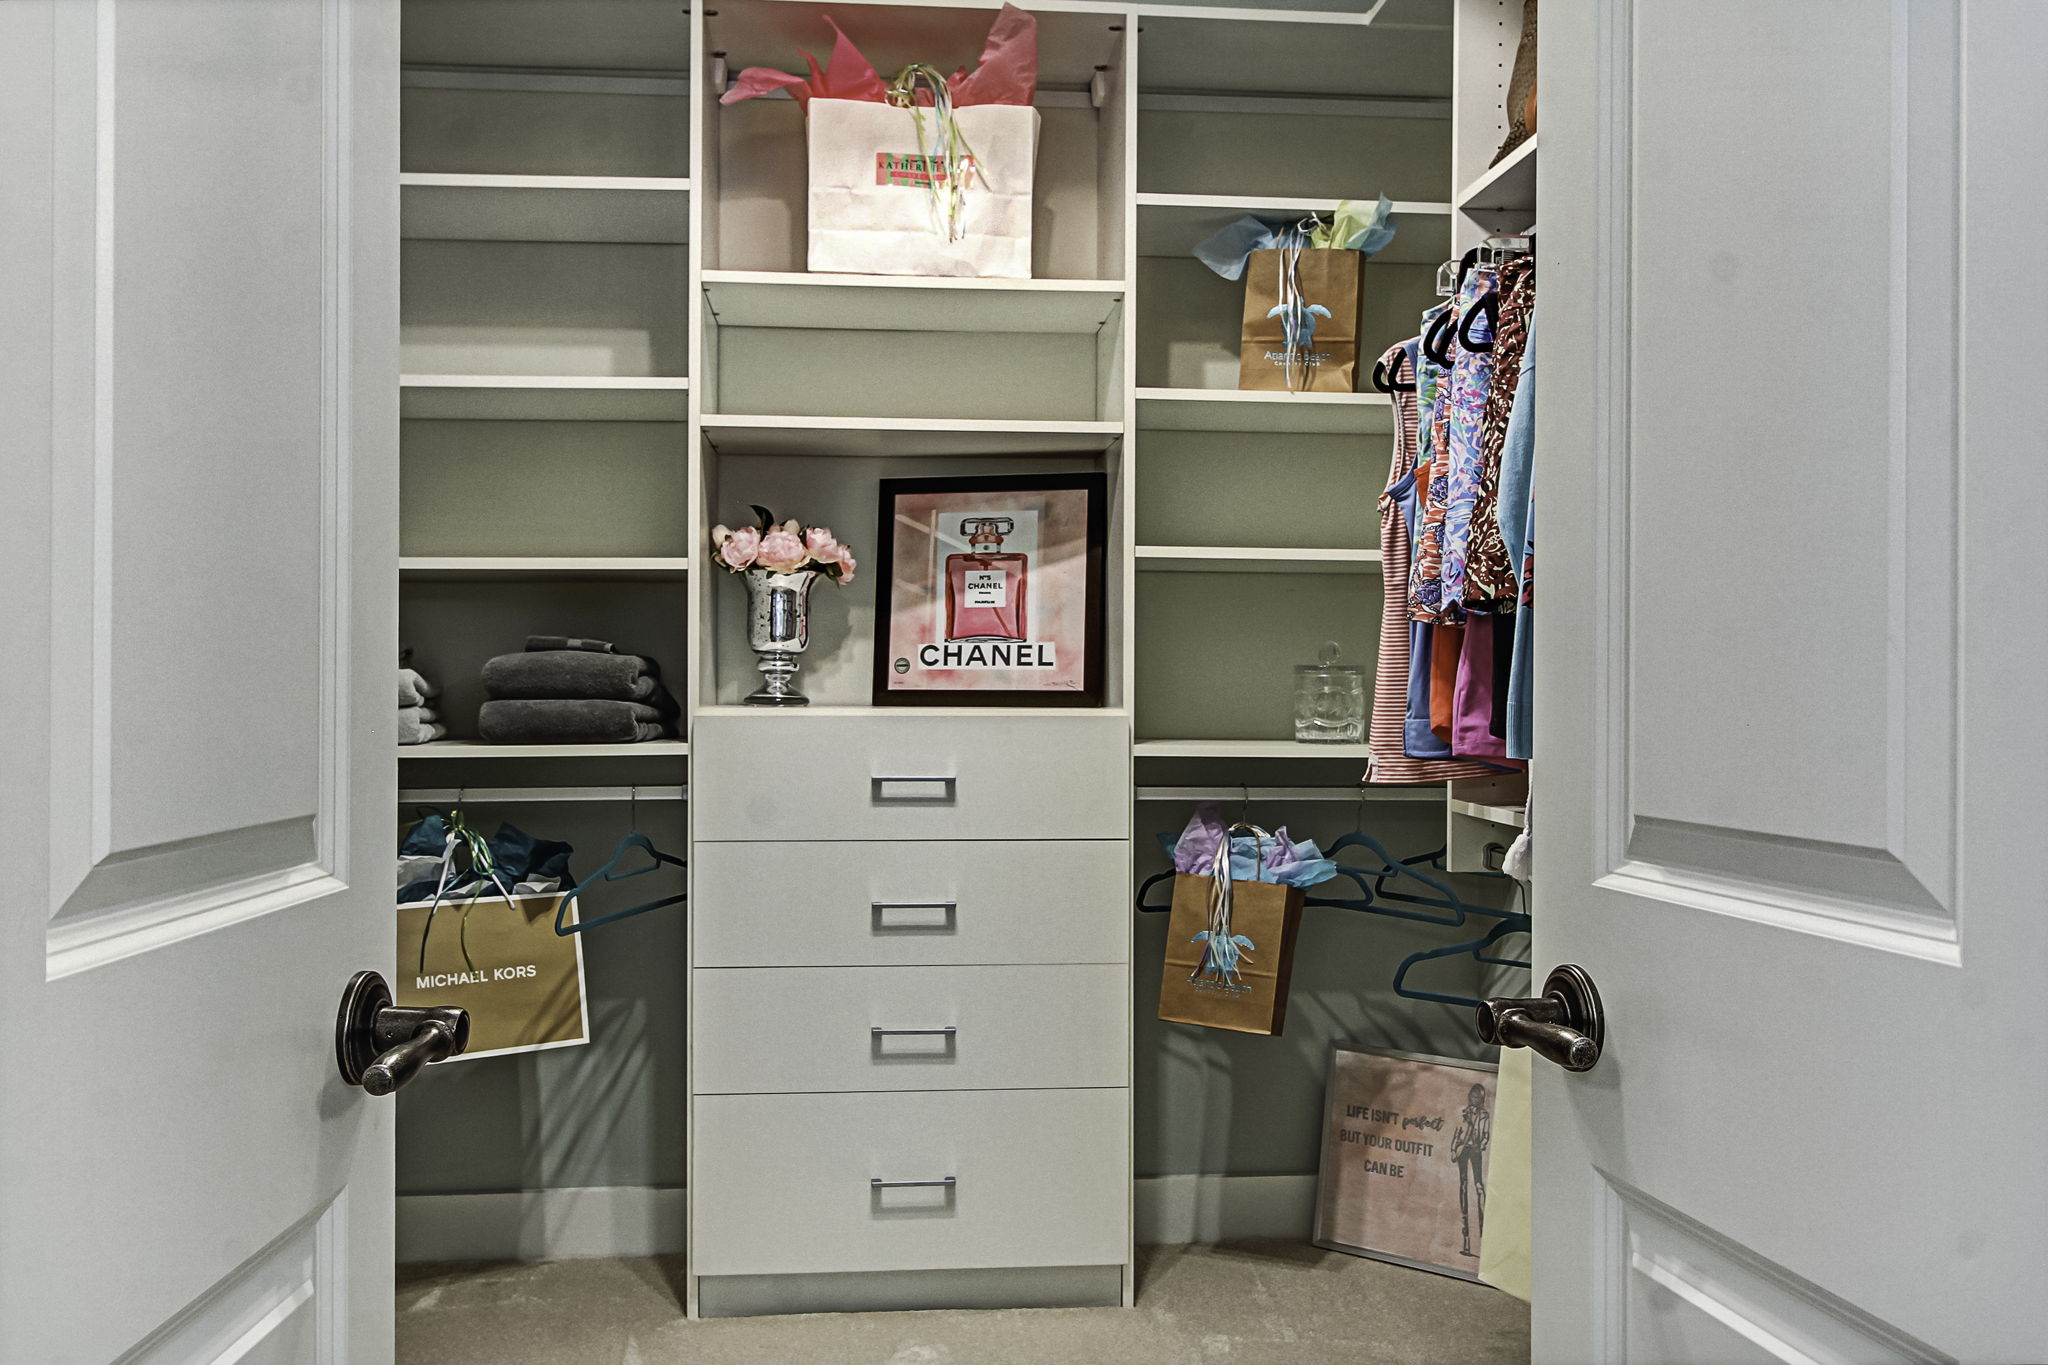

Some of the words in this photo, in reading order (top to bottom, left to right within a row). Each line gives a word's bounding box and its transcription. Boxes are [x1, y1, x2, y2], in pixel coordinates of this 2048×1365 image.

[967, 582, 1003, 590] CHANEL
[919, 644, 1054, 667] CHANEL
[415, 970, 489, 989] MICHAEL
[493, 964, 537, 981] KORS
[1346, 1104, 1369, 1120] LIFE
[1371, 1108, 1399, 1125] ISN'T
[1402, 1114, 1444, 1131] perfect
[1340, 1128, 1362, 1144] BUT
[1362, 1133, 1392, 1150] YOUR
[1394, 1139, 1434, 1157] OUTFIT
[1363, 1159, 1387, 1175] CAN
[1389, 1163, 1405, 1178] BE
